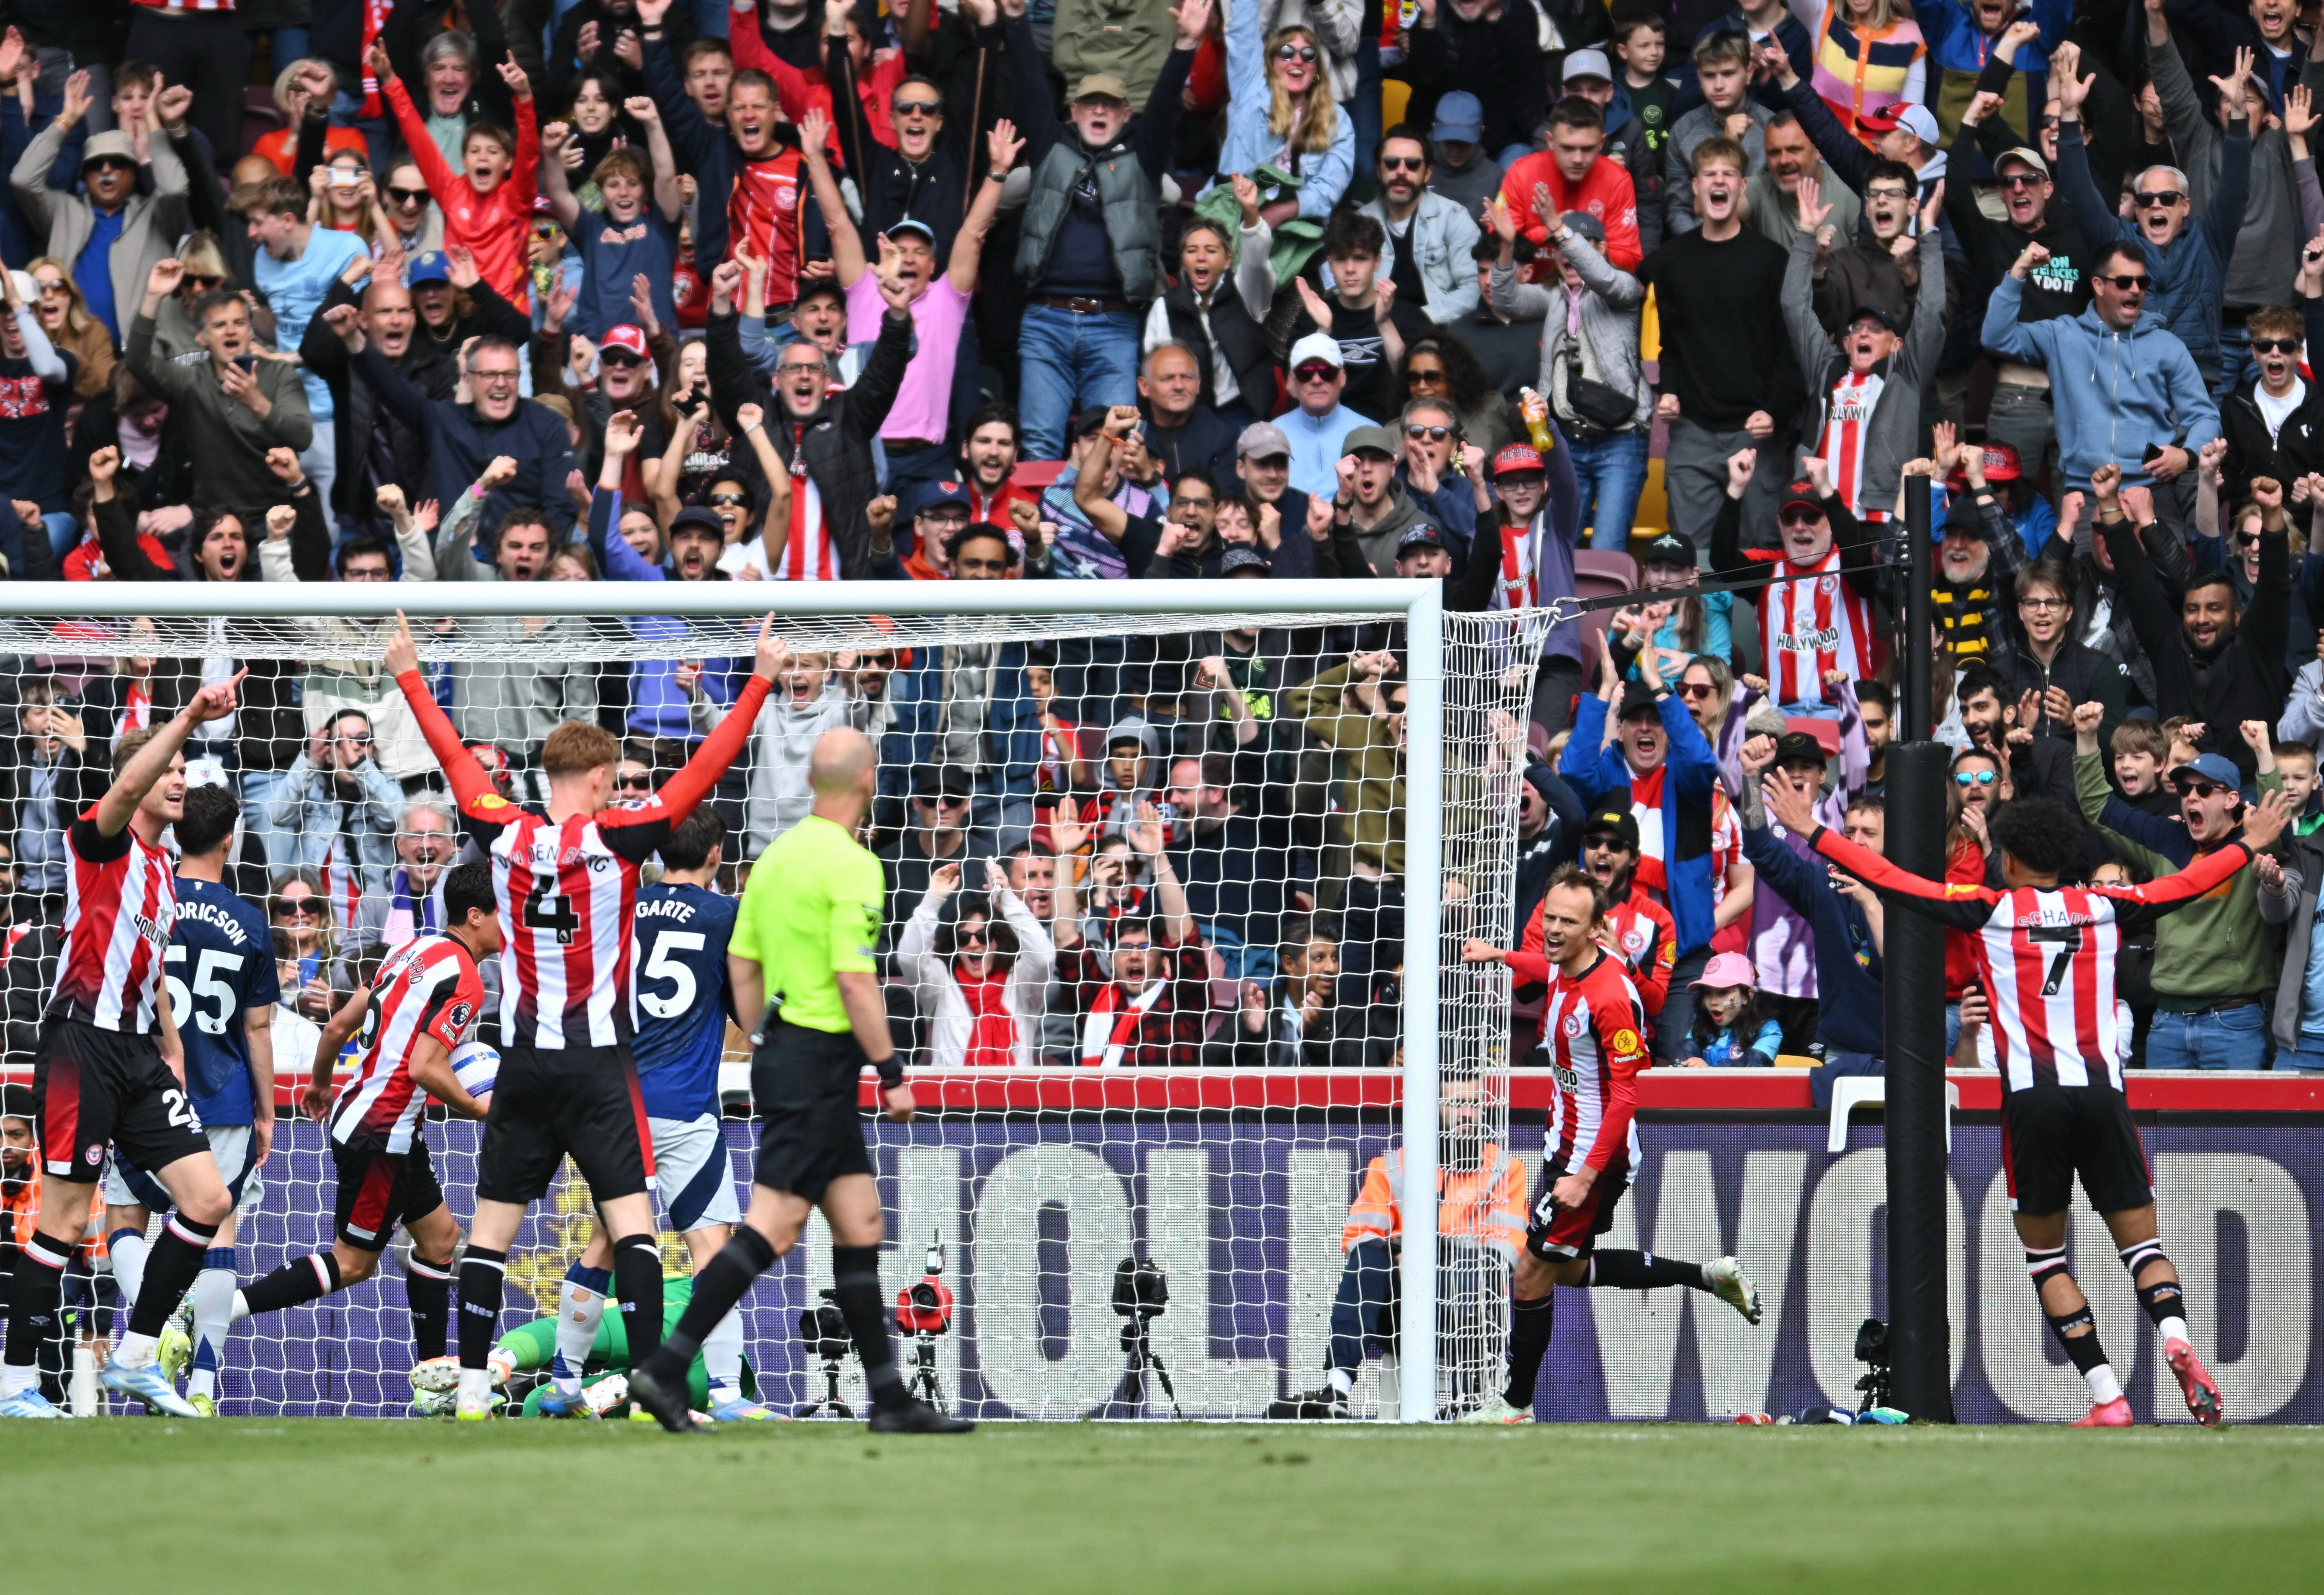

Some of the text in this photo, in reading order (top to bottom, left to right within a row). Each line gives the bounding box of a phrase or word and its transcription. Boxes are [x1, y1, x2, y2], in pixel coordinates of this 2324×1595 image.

[2043, 276, 2062, 290] DO
[2064, 279, 2074, 293] IT
[1500, 447, 1538, 463] THE BEES
[1501, 574, 1528, 591] Pensi
[1777, 627, 1839, 650] HOLLYWOOD
[527, 844, 560, 865] DEN
[175, 902, 247, 946] DRICSON
[524, 874, 581, 946] 4
[635, 900, 696, 924] GARTE
[134, 912, 172, 954] HOLLYWO
[634, 930, 706, 1018] 5
[2028, 927, 2082, 997] 7
[164, 945, 245, 1035] 55
[361, 972, 397, 1050] 6
